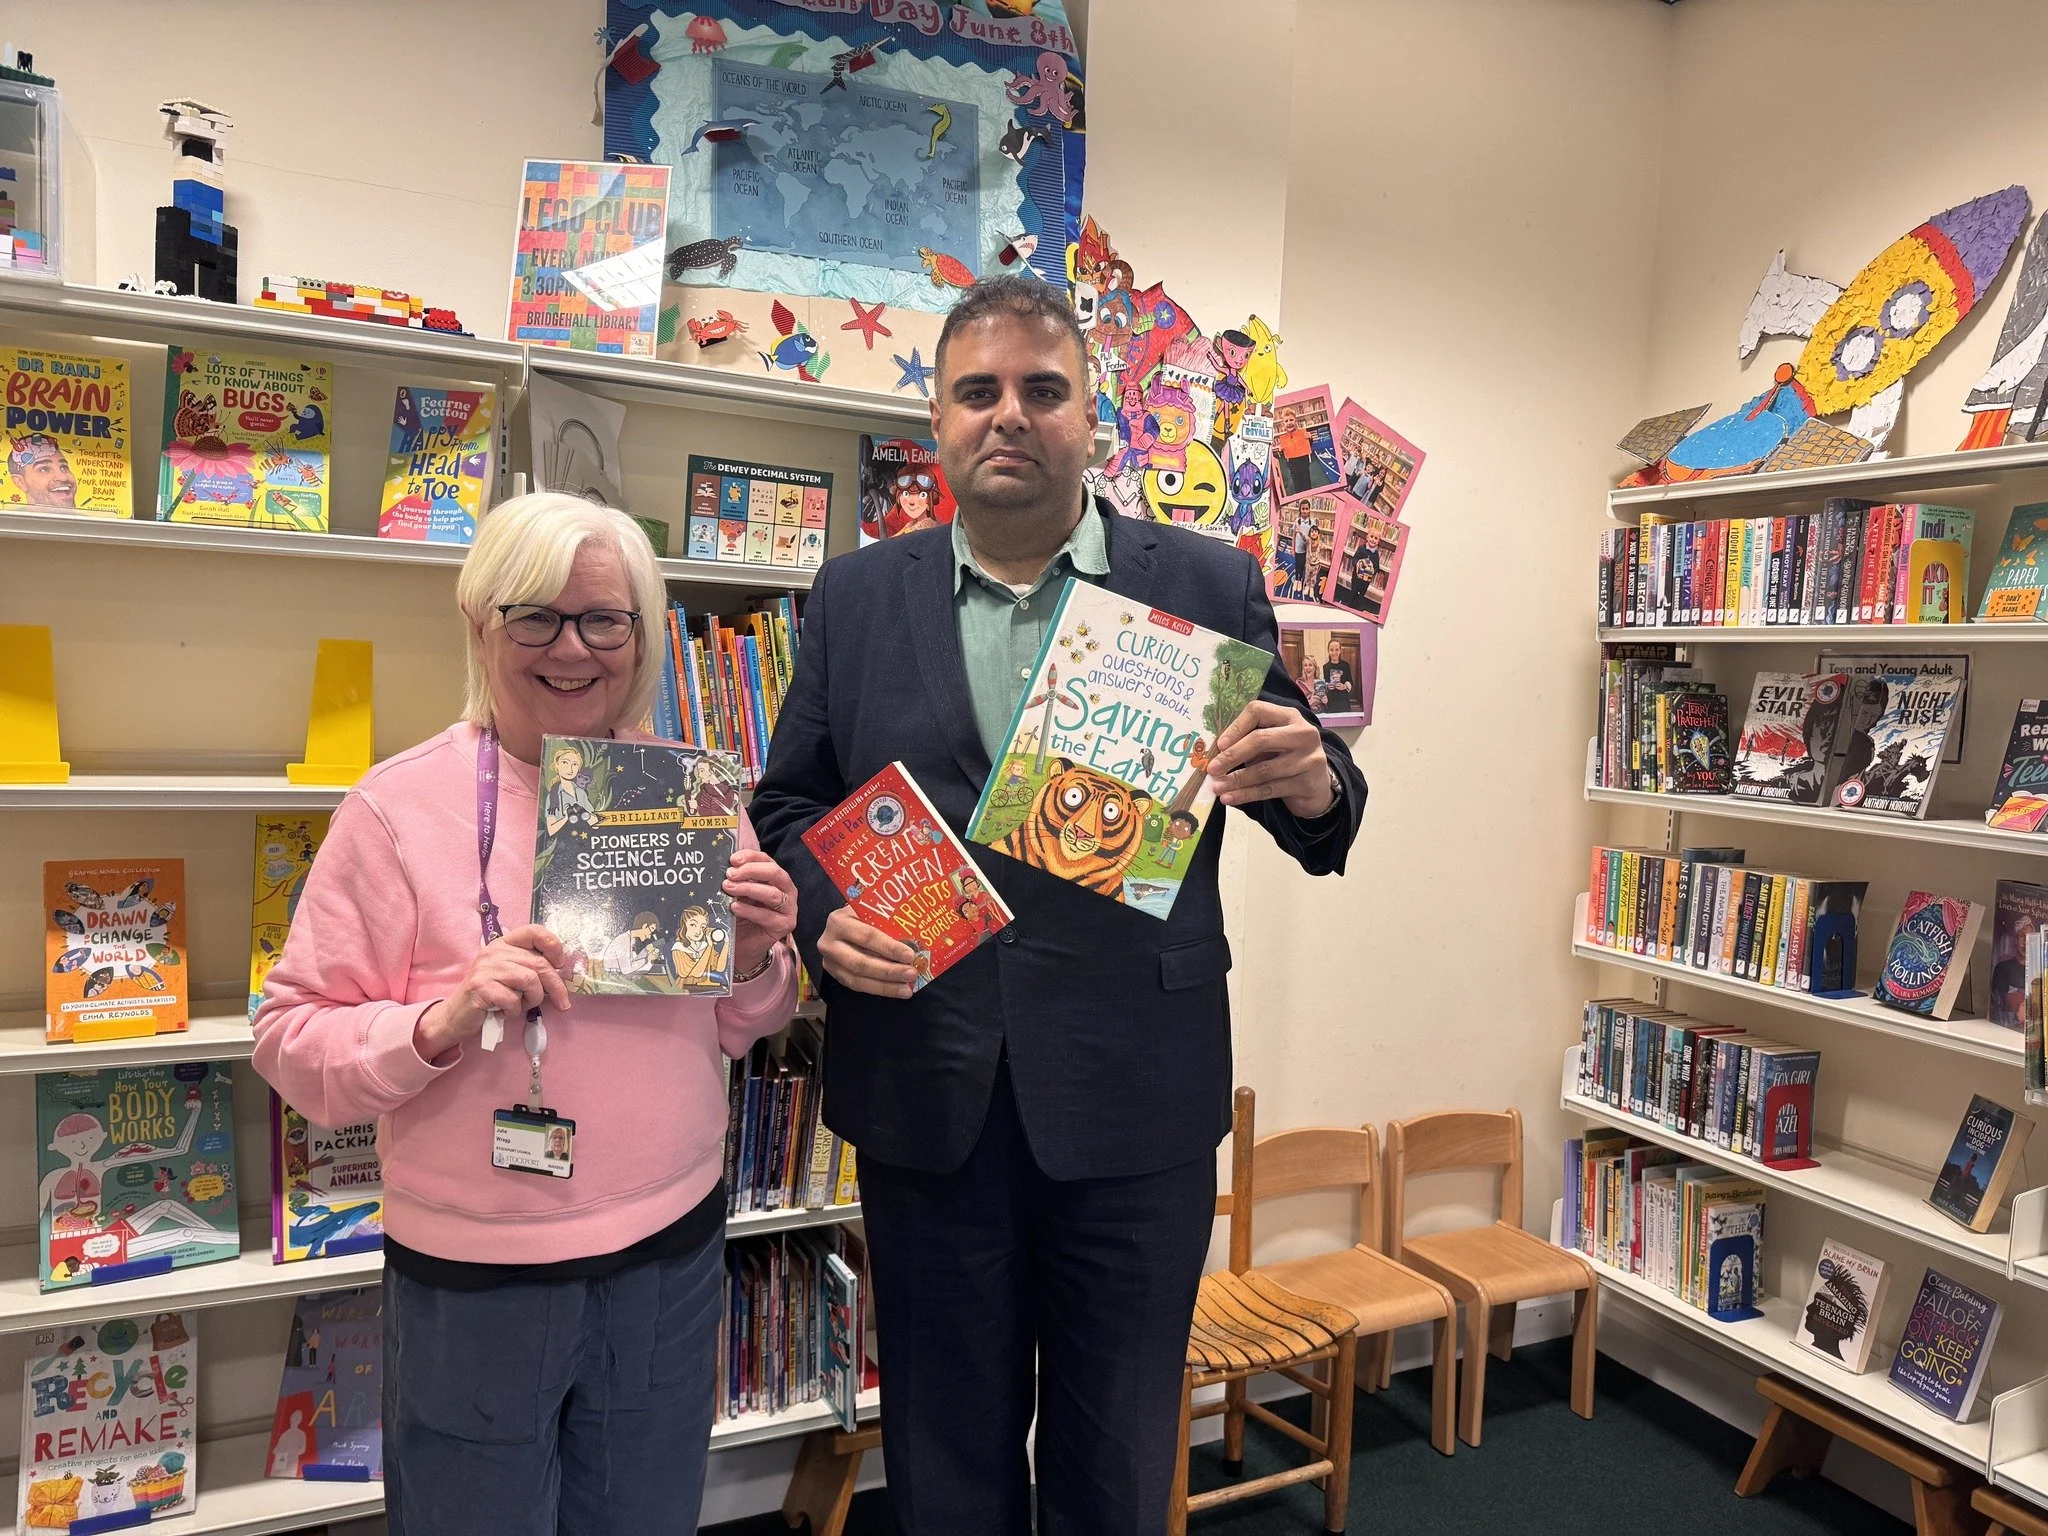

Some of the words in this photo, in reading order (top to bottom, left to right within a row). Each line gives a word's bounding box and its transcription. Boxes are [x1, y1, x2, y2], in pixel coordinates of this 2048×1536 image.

[872, 0, 940, 34] Day
[952, 7, 1022, 44] June
[1029, 20, 1074, 52] 8th
[722, 72, 751, 87] OCEANS
[752, 75, 764, 87] OF
[766, 78, 780, 91] THE
[782, 81, 806, 95] WORLD
[859, 95, 882, 110] ARCTIC
[885, 99, 907, 112] OCEAN
[788, 148, 821, 163] ATLANTIC
[733, 169, 760, 183] PACIFIC
[793, 160, 817, 174] OCEAN
[734, 183, 759, 196] OCEAN
[942, 178, 967, 191] PACIFIC
[885, 199, 909, 212] INDIAN
[945, 192, 967, 204] OCEAN
[521, 198, 586, 233] LEGO
[595, 200, 662, 237] CLUB
[885, 212, 908, 225] OCEAN
[819, 232, 857, 247] SOUTHERN
[860, 238, 882, 250] OCEAN
[532, 248, 578, 269] EVERY
[522, 276, 577, 297] 3.30PM
[527, 311, 590, 328] BRIDGEHALL
[595, 314, 639, 331] LIBRARY
[18, 357, 43, 372] DR
[51, 361, 101, 379] RANJ
[207, 364, 236, 375] LOTS
[239, 367, 255, 377] OF
[259, 369, 304, 383] THINGS
[204, 375, 220, 386] TO
[225, 378, 260, 389] KNOW
[263, 381, 305, 394] ABOUT
[223, 388, 285, 412] BUGS
[420, 397, 471, 411] Fearne
[7, 407, 112, 438] POWER
[420, 407, 468, 421] Cotton
[398, 424, 458, 453] HAPPY
[79, 449, 111, 458] TOOLKIT
[872, 446, 909, 461] AMELIA
[912, 448, 939, 463] EARH
[76, 459, 124, 469] UNDERSTAND
[100, 469, 122, 478] TRAIN
[703, 461, 717, 471] The
[718, 463, 749, 475] DEWEY
[750, 467, 788, 480] DECIMAL
[790, 472, 821, 484] SYSTEM
[78, 478, 97, 486] YOUR
[99, 479, 127, 488] UNIQUE
[93, 487, 115, 495] BRAIN
[408, 478, 421, 494] to
[402, 505, 431, 515] journey
[433, 507, 462, 515] through
[405, 513, 422, 522] body
[433, 515, 449, 524] help
[432, 523, 455, 531] happy
[1870, 522, 1879, 549] AFTER
[1921, 519, 1945, 538] Indi
[1728, 528, 1739, 565] MOONRISE
[1868, 554, 1876, 568] THE
[2005, 567, 2039, 585] PAPER
[1637, 582, 1646, 613] BECK
[1922, 586, 1935, 604] IT
[1829, 663, 1852, 675] Teen
[1855, 663, 1876, 675] and
[1878, 663, 1917, 677] Young
[1920, 663, 1953, 675] Adult
[659, 670, 672, 717] CHILDREN'S
[1088, 669, 1153, 699] answers
[1758, 686, 1807, 701] EVIL
[1183, 687, 1195, 701] &
[1898, 691, 1951, 709] NIGHT
[1684, 701, 1710, 716] TERRY
[1755, 701, 1804, 718] STAR
[1899, 709, 1945, 726] RISE
[1054, 677, 1200, 773] Saving
[1677, 709, 1722, 729] PRATCHETT
[1051, 733, 1086, 756] the
[1089, 734, 1179, 806] Earth
[1696, 771, 1715, 780] YOU
[1735, 783, 1761, 796] ANTHONY
[1761, 786, 1791, 798] HOROWITZ
[484, 801, 492, 825] Here
[1862, 797, 1888, 809] ANTHONY
[1889, 800, 1918, 813] HOROWITZ
[610, 811, 679, 823] BRILLIANT
[691, 817, 728, 827] WOMEN
[482, 836, 490, 858] Help
[590, 832, 670, 849] PIONEERS
[676, 832, 696, 846] OF
[576, 849, 667, 870] SCIENCE
[673, 850, 704, 865] AND
[851, 827, 924, 888] GREAT
[572, 867, 706, 890] TECHNOLOGY
[859, 848, 945, 920] WOMEN
[1678, 861, 1689, 899] NESS
[1758, 883, 1769, 906] SAINT
[893, 880, 951, 935] ARTISTS
[919, 914, 932, 929] and
[930, 905, 947, 919] their
[1807, 906, 1815, 928] FACE
[87, 909, 147, 929] DRAWN
[920, 909, 959, 947] STORIES
[1755, 908, 1765, 933] DEATH
[91, 928, 153, 945] CHANGE
[1907, 919, 1952, 955] CATFISH
[92, 950, 147, 963] WORLD
[1890, 959, 1942, 985] ROLLING
[108, 1010, 150, 1019] REYNOLDS
[1774, 1070, 1789, 1086] FOX
[1790, 1070, 1811, 1084] GIRL
[108, 1087, 176, 1125] BODY
[110, 1115, 175, 1145] WORKS
[335, 1124, 374, 1136] CHRIS
[1967, 1115, 2003, 1140] CURIOUS
[1967, 1127, 1996, 1146] INCIDENT
[1971, 1137, 1985, 1149] DOG
[332, 1161, 378, 1173] SUPERHERO
[505, 1156, 540, 1166] STOCKPORT
[330, 1171, 381, 1187] ANIMALS
[1822, 1248, 1845, 1264] BLAME
[1846, 1258, 1857, 1269] MY
[1857, 1262, 1879, 1279] BRAIN
[1826, 1281, 1857, 1315] AMAZING
[1918, 1288, 1951, 1319] FALL
[1928, 1274, 1952, 1294] Clare
[1952, 1287, 1989, 1314] Balding
[1815, 1298, 1854, 1323] TEENAGE
[1818, 1307, 1847, 1327] BRAIN
[1914, 1306, 1937, 1325] GET
[1939, 1323, 1977, 1346] BACK
[36, 1332, 54, 1345] DK
[1908, 1319, 1933, 1343] ON
[1937, 1335, 1973, 1364] KEEP
[355, 1364, 373, 1375] OF
[96, 1409, 117, 1421] AND
[34, 1411, 178, 1462] REMAKE
[48, 1460, 82, 1471] Creative
[84, 1456, 117, 1467] projects
[120, 1454, 132, 1462] for
[149, 1447, 166, 1457] kids
